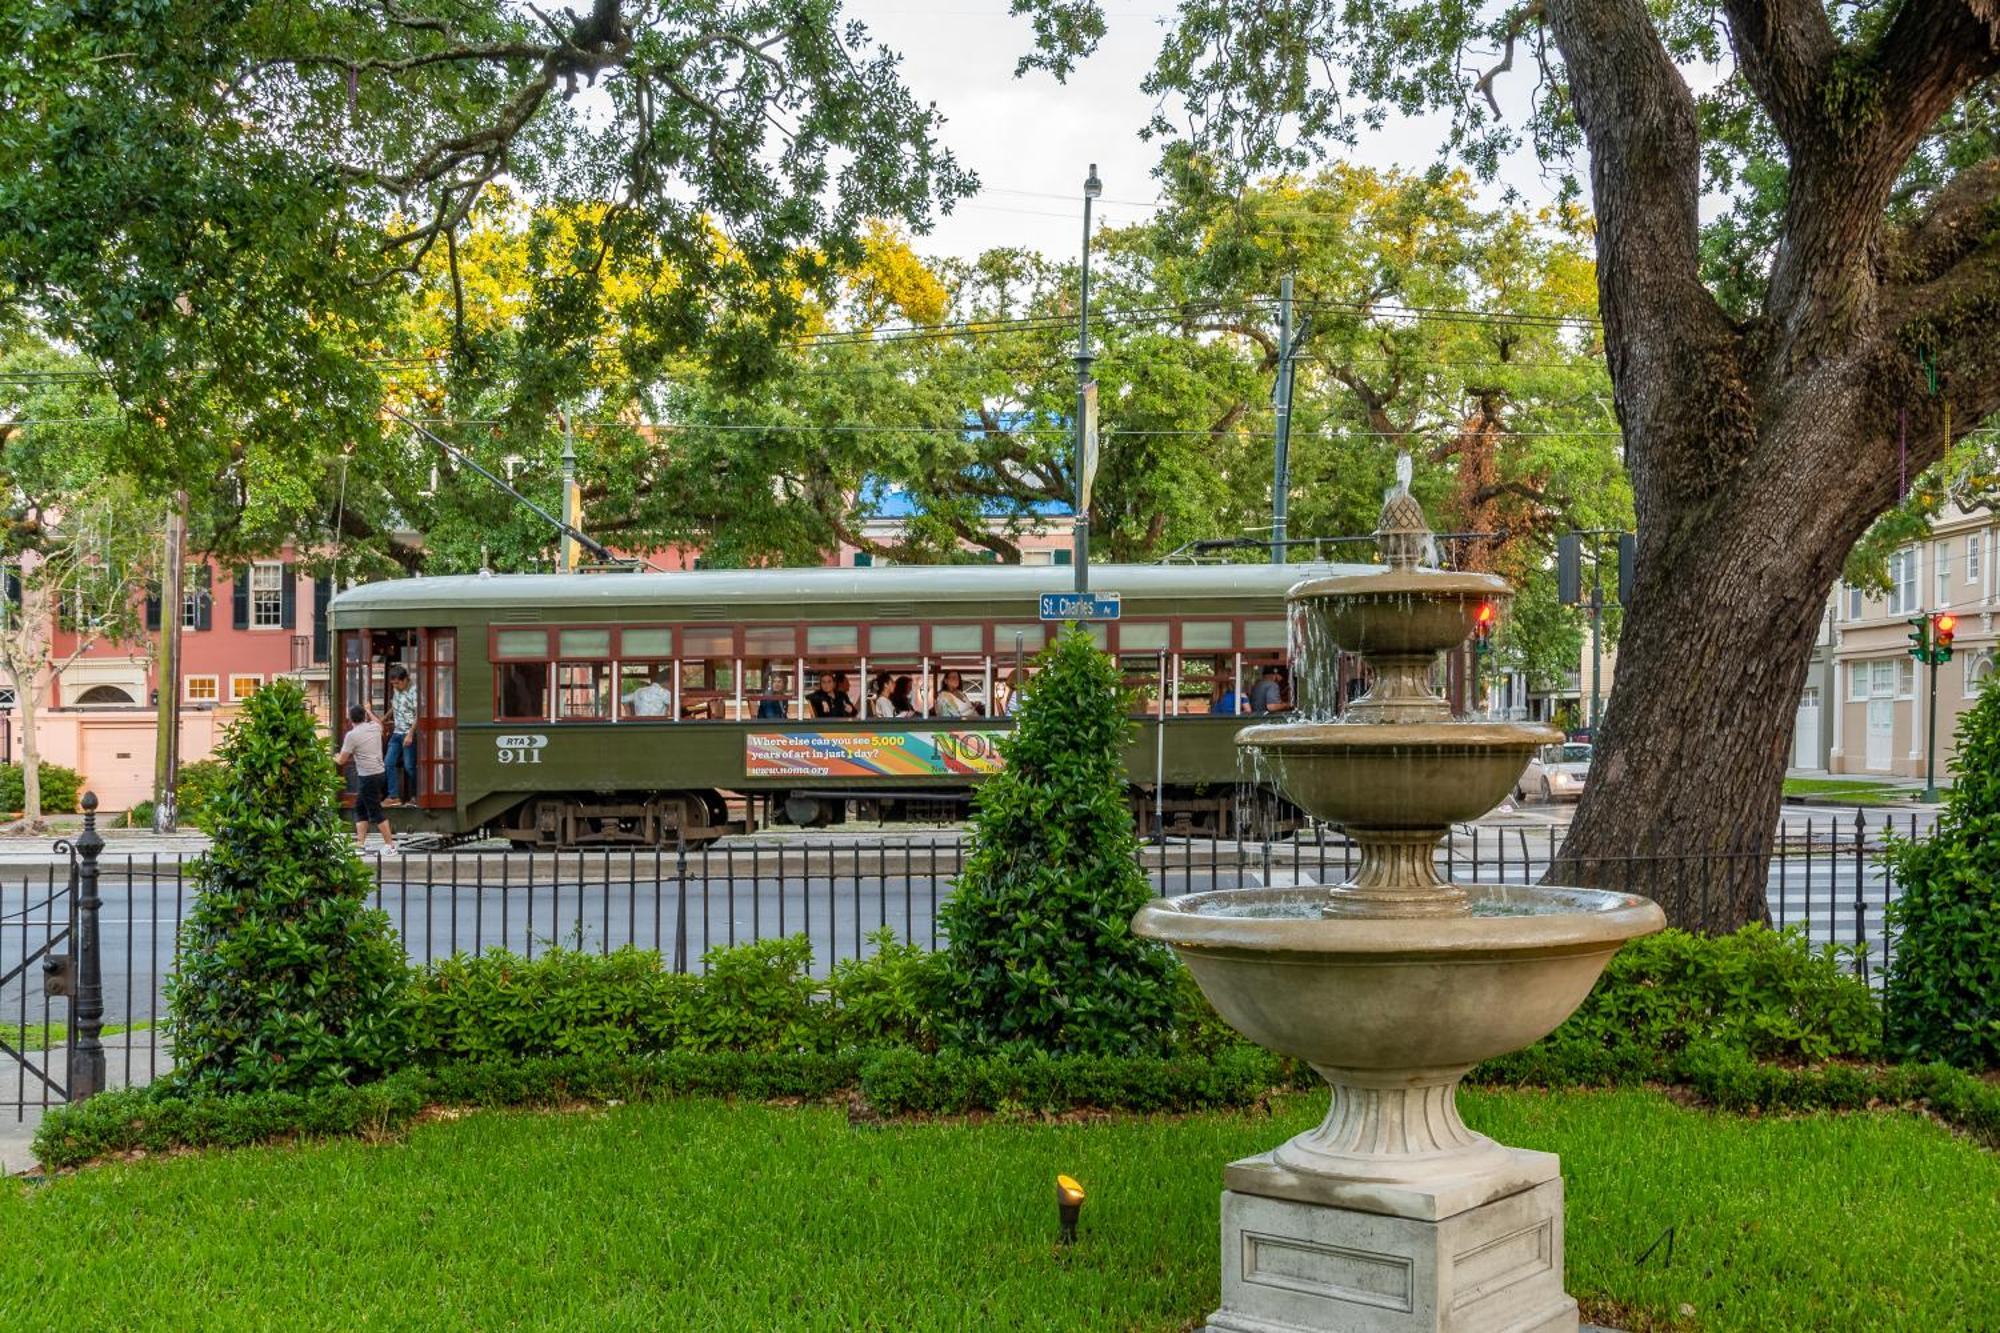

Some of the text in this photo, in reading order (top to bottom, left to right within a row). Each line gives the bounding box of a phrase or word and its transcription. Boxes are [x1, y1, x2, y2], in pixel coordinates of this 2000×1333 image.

[1043, 598, 1056, 616] St.
[1059, 598, 1095, 616] Charles
[506, 738, 525, 746] RTA
[752, 737, 787, 746] Where
[789, 737, 809, 746] else
[811, 738, 830, 746] can
[831, 738, 852, 748] you
[871, 736, 905, 747] 5,000
[931, 734, 1000, 760] NO
[498, 749, 542, 764] 911
[752, 750, 780, 760] years
[782, 750, 794, 759] of
[812, 750, 823, 758] in
[824, 749, 846, 760] just
[847, 749, 853, 759] 1
[854, 749, 879, 759] day?
[752, 767, 829, 776] www.noma.org
